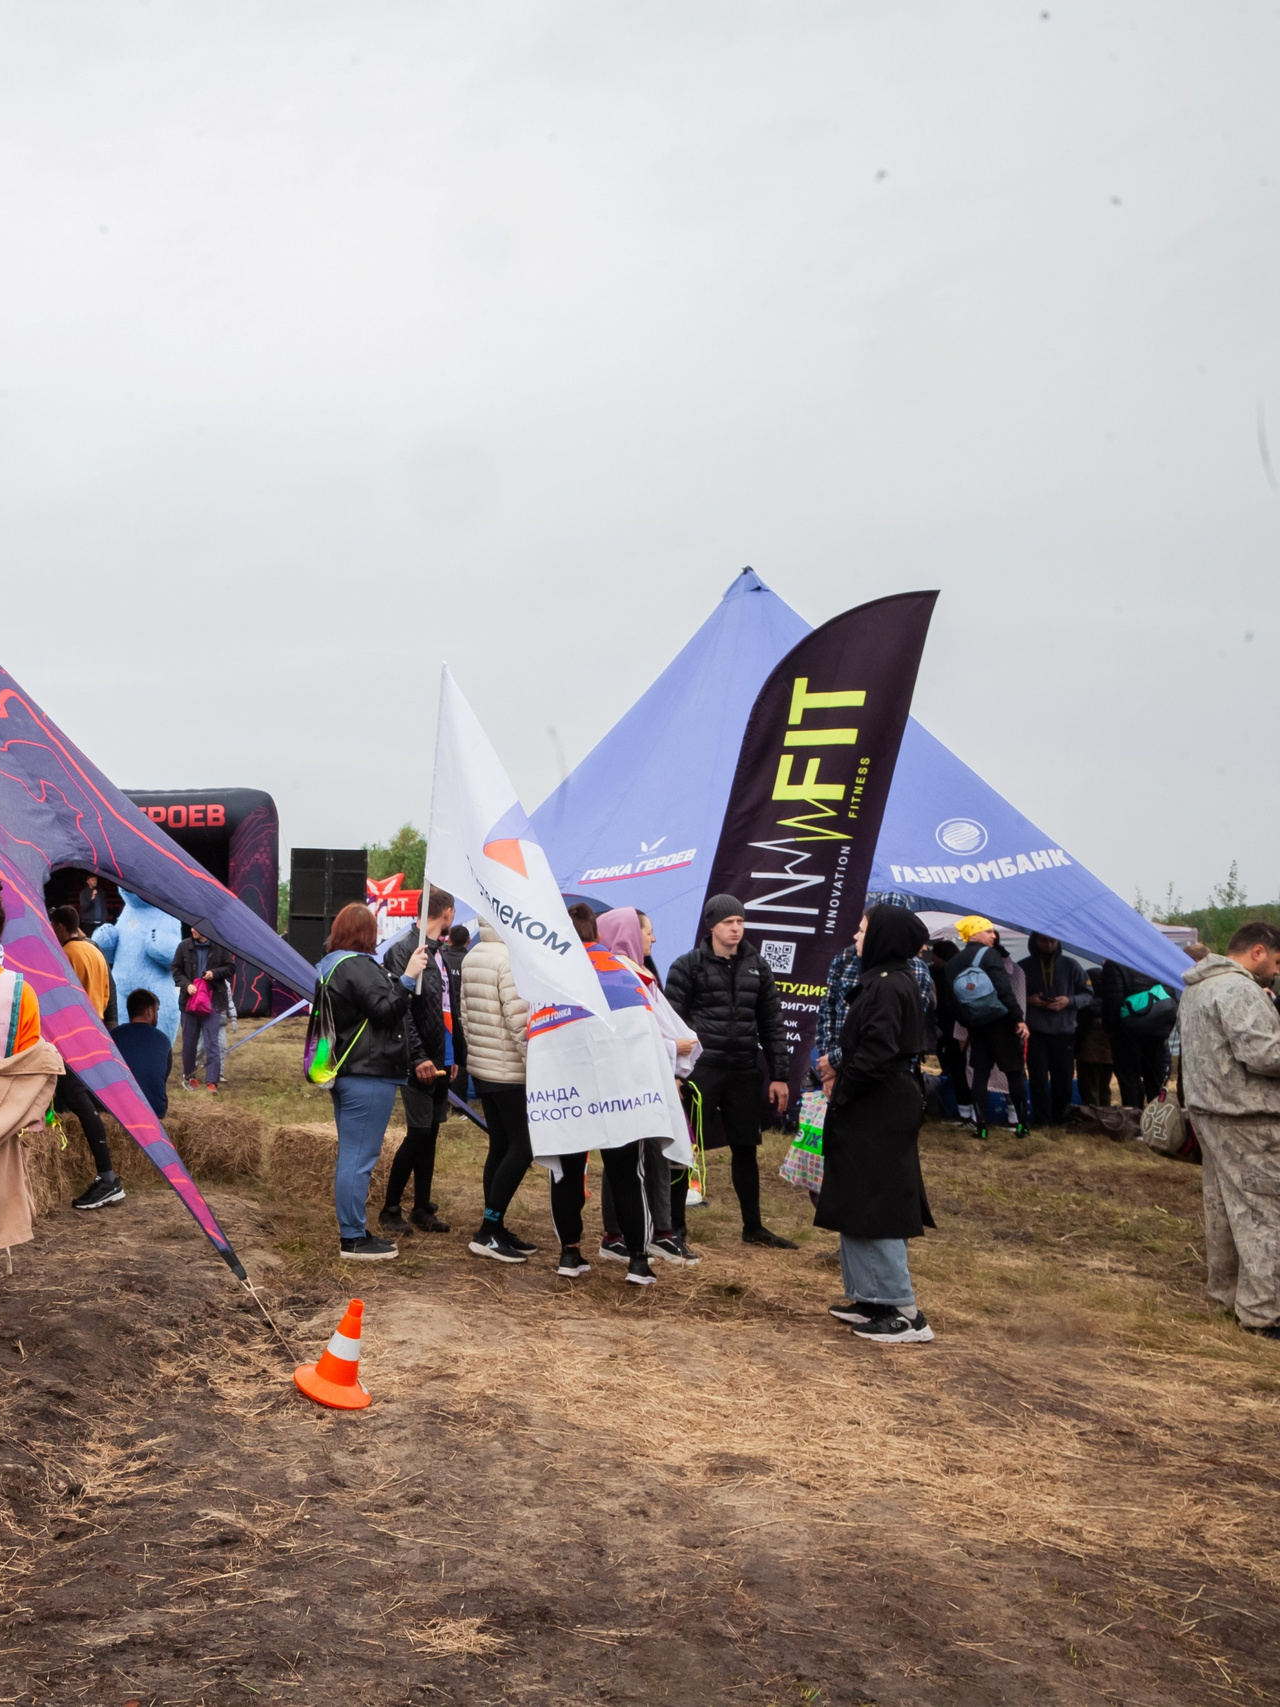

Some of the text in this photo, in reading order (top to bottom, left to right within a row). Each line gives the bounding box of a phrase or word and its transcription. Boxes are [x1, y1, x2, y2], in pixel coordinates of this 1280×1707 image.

[848, 757, 871, 818] FITNESS
[139, 804, 226, 828] РОЕВ
[581, 848, 697, 881] ГОНКА ГЕРОЕВ
[890, 849, 1072, 884] ГАЗПРОМБАНК
[824, 846, 851, 934] INNOVATION
[477, 876, 572, 956] леком
[526, 1092, 663, 1123] СКОГО ФИЛИАЛА
